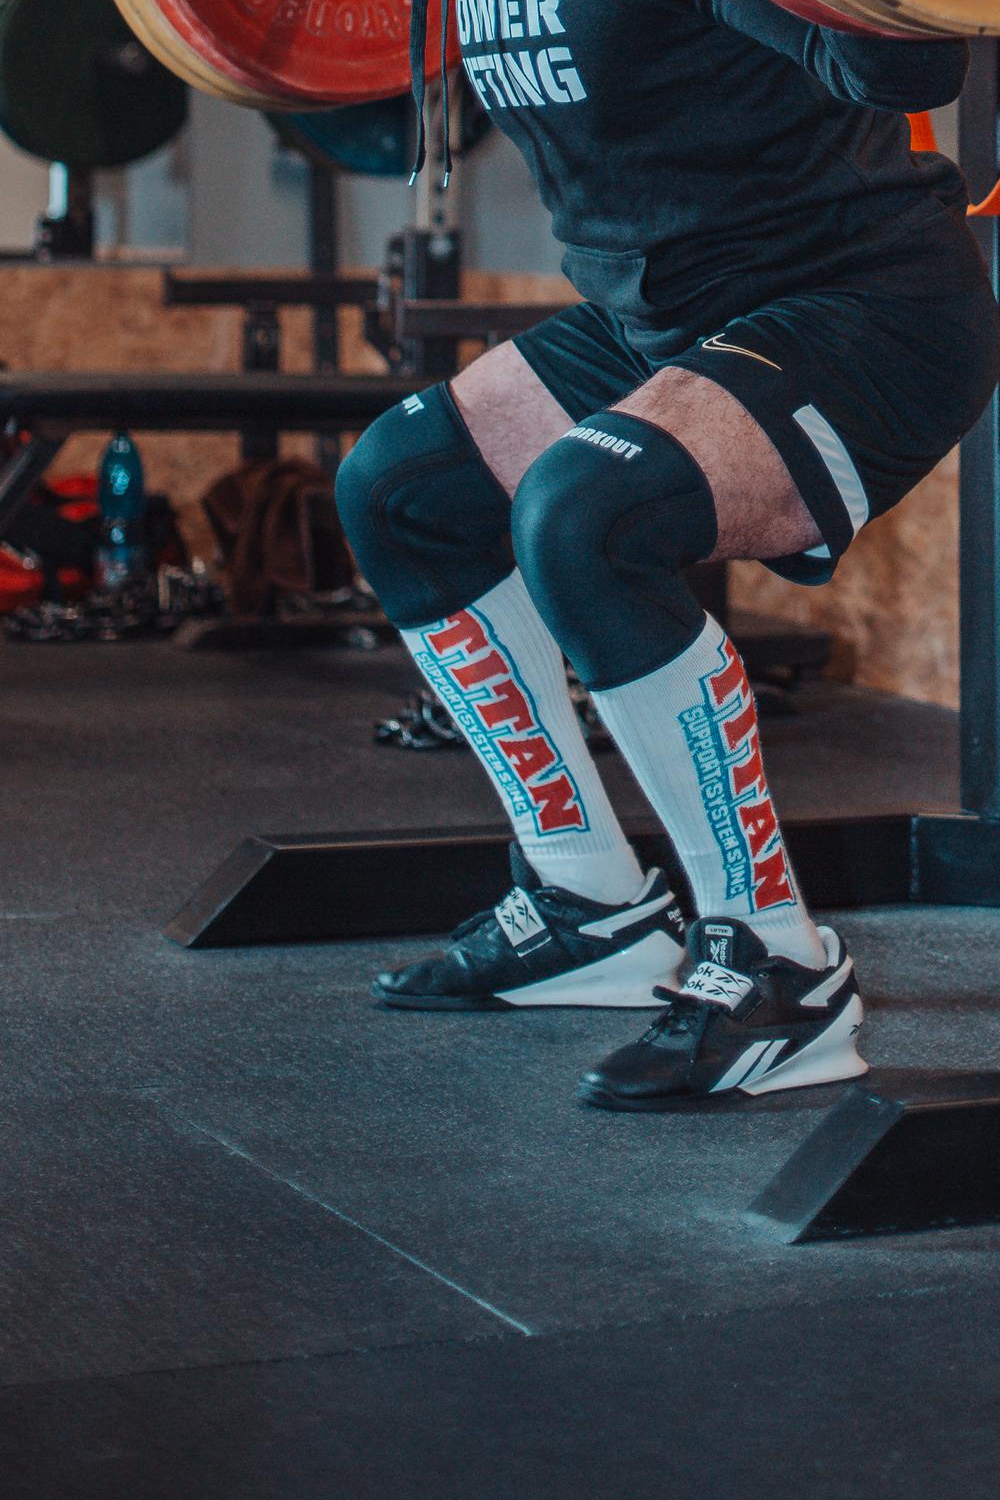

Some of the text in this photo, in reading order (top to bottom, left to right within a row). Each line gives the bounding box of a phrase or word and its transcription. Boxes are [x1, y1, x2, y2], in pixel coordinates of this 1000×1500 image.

[462, 47, 587, 110] FTING
[415, 652, 467, 713] SUPPORT
[425, 607, 586, 833] TITAN
[682, 705, 721, 780] SUPPORT
[709, 637, 797, 910] TITAN
[719, 938, 728, 966] Reebo
